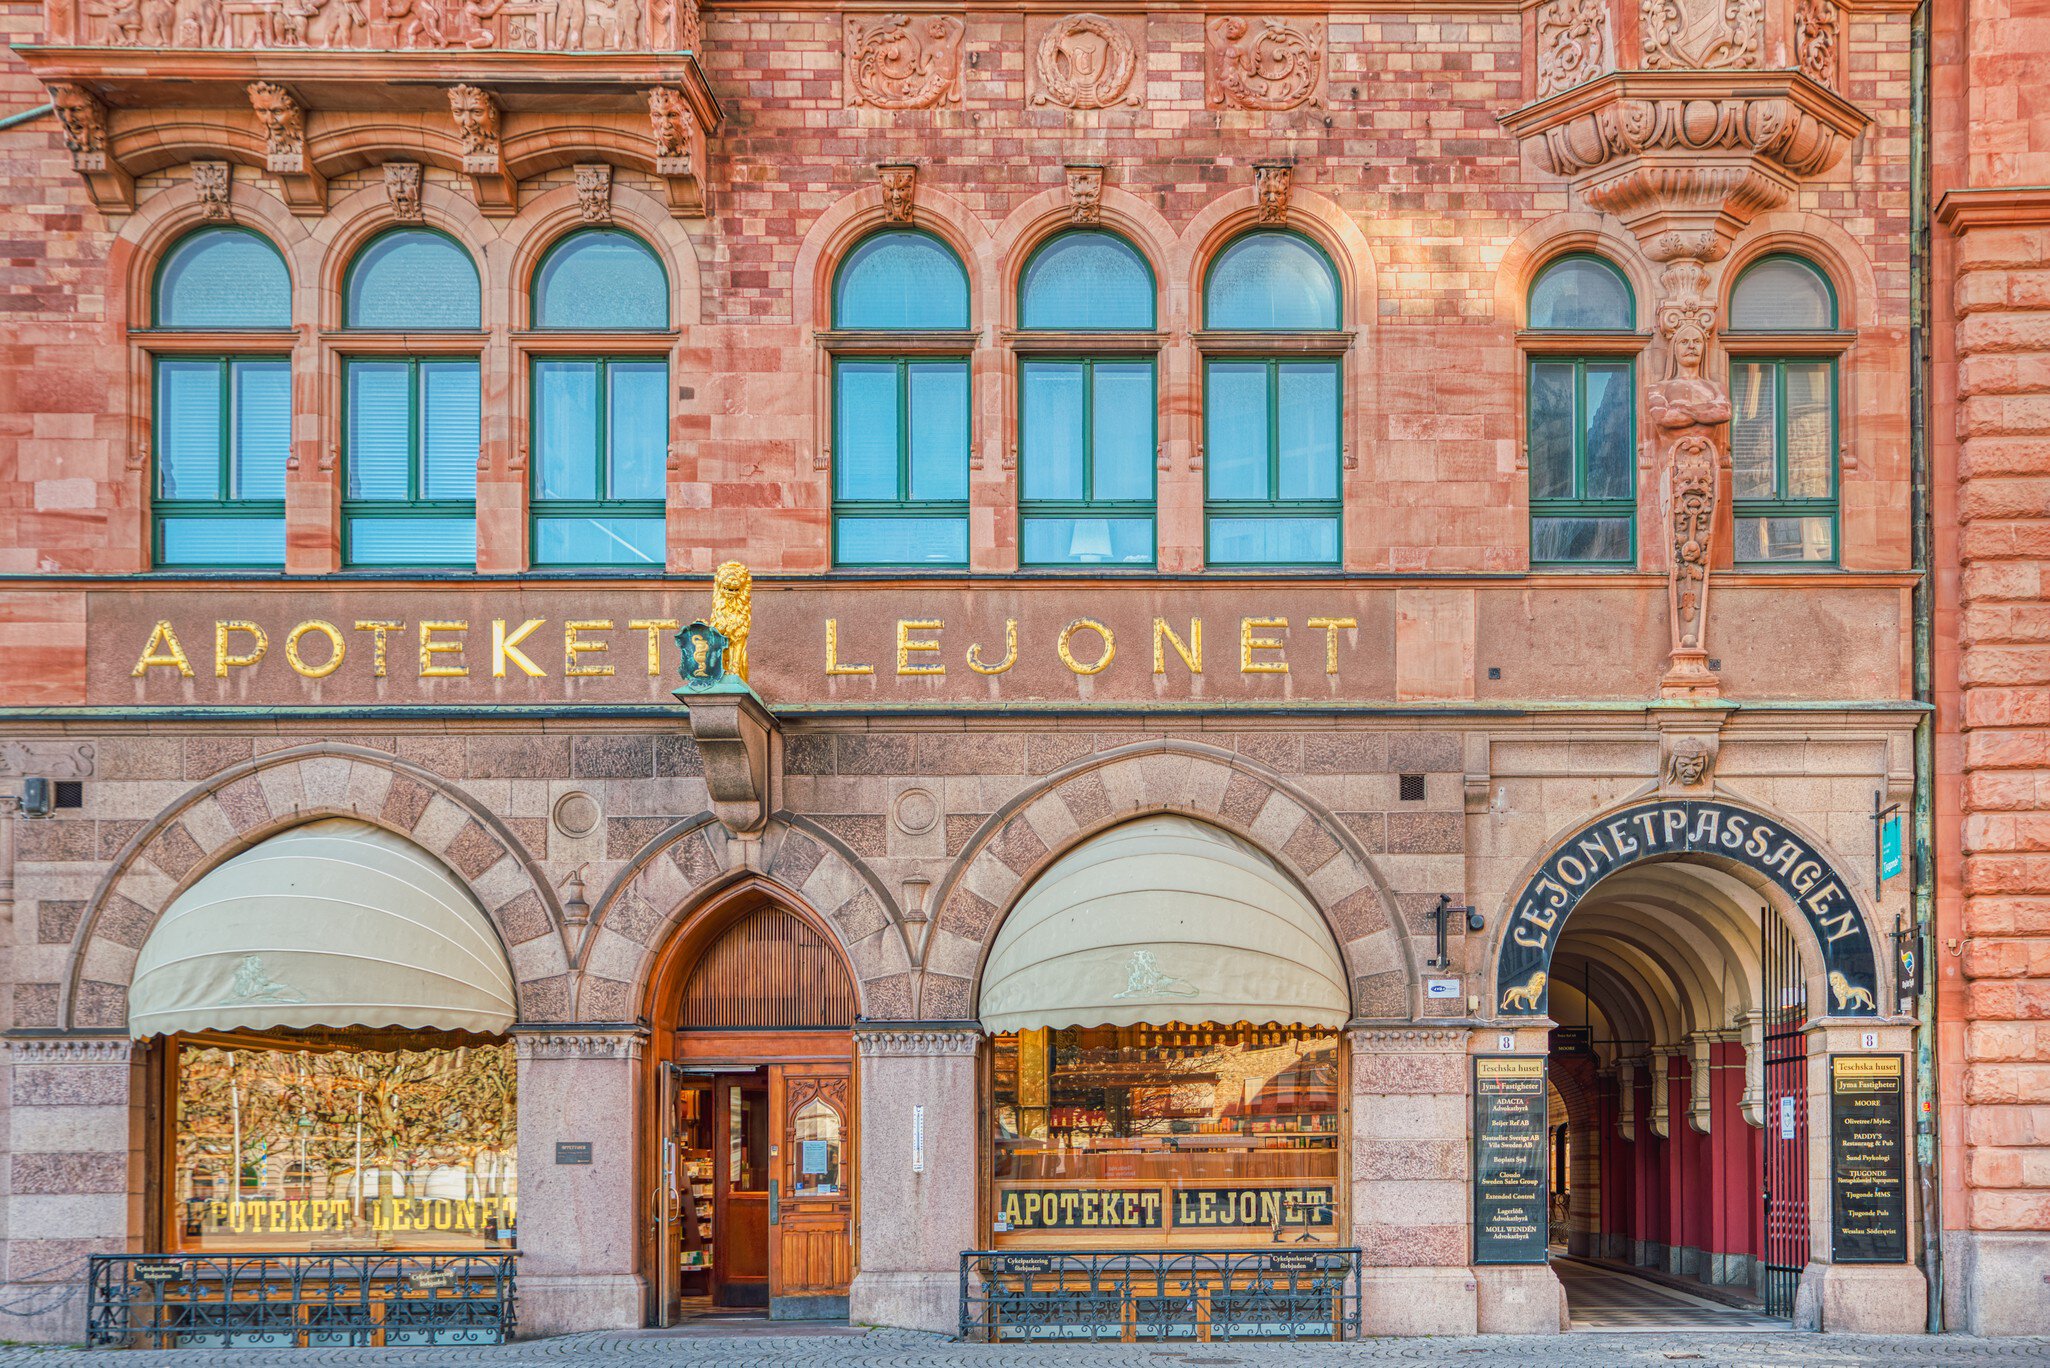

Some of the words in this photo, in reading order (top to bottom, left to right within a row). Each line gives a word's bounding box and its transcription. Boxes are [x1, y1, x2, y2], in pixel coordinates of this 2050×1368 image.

[131, 618, 679, 678] APOTEKET
[825, 616, 1358, 675] LEJONET
[1514, 808, 1860, 949] LEJONETPASSAGEN
[1503, 1036, 1510, 1049] 8
[1866, 1034, 1873, 1047] 8
[1481, 1064, 1516, 1072] Teschska
[1518, 1064, 1540, 1072] huset
[1482, 1082, 1500, 1092] Jyma
[1501, 1082, 1539, 1091] Fastigheter
[1839, 1081, 1857, 1090] Jyma
[1859, 1081, 1896, 1090] Fastigheter
[1846, 1191, 1873, 1199] Tjugonde
[1874, 1191, 1890, 1199] MMS
[1005, 1192, 1160, 1226] APOTEKET
[1179, 1190, 1326, 1224] LEJONET
[1007, 1257, 1049, 1265] Cykelparkering
[1272, 1255, 1314, 1263] Cykelparkering
